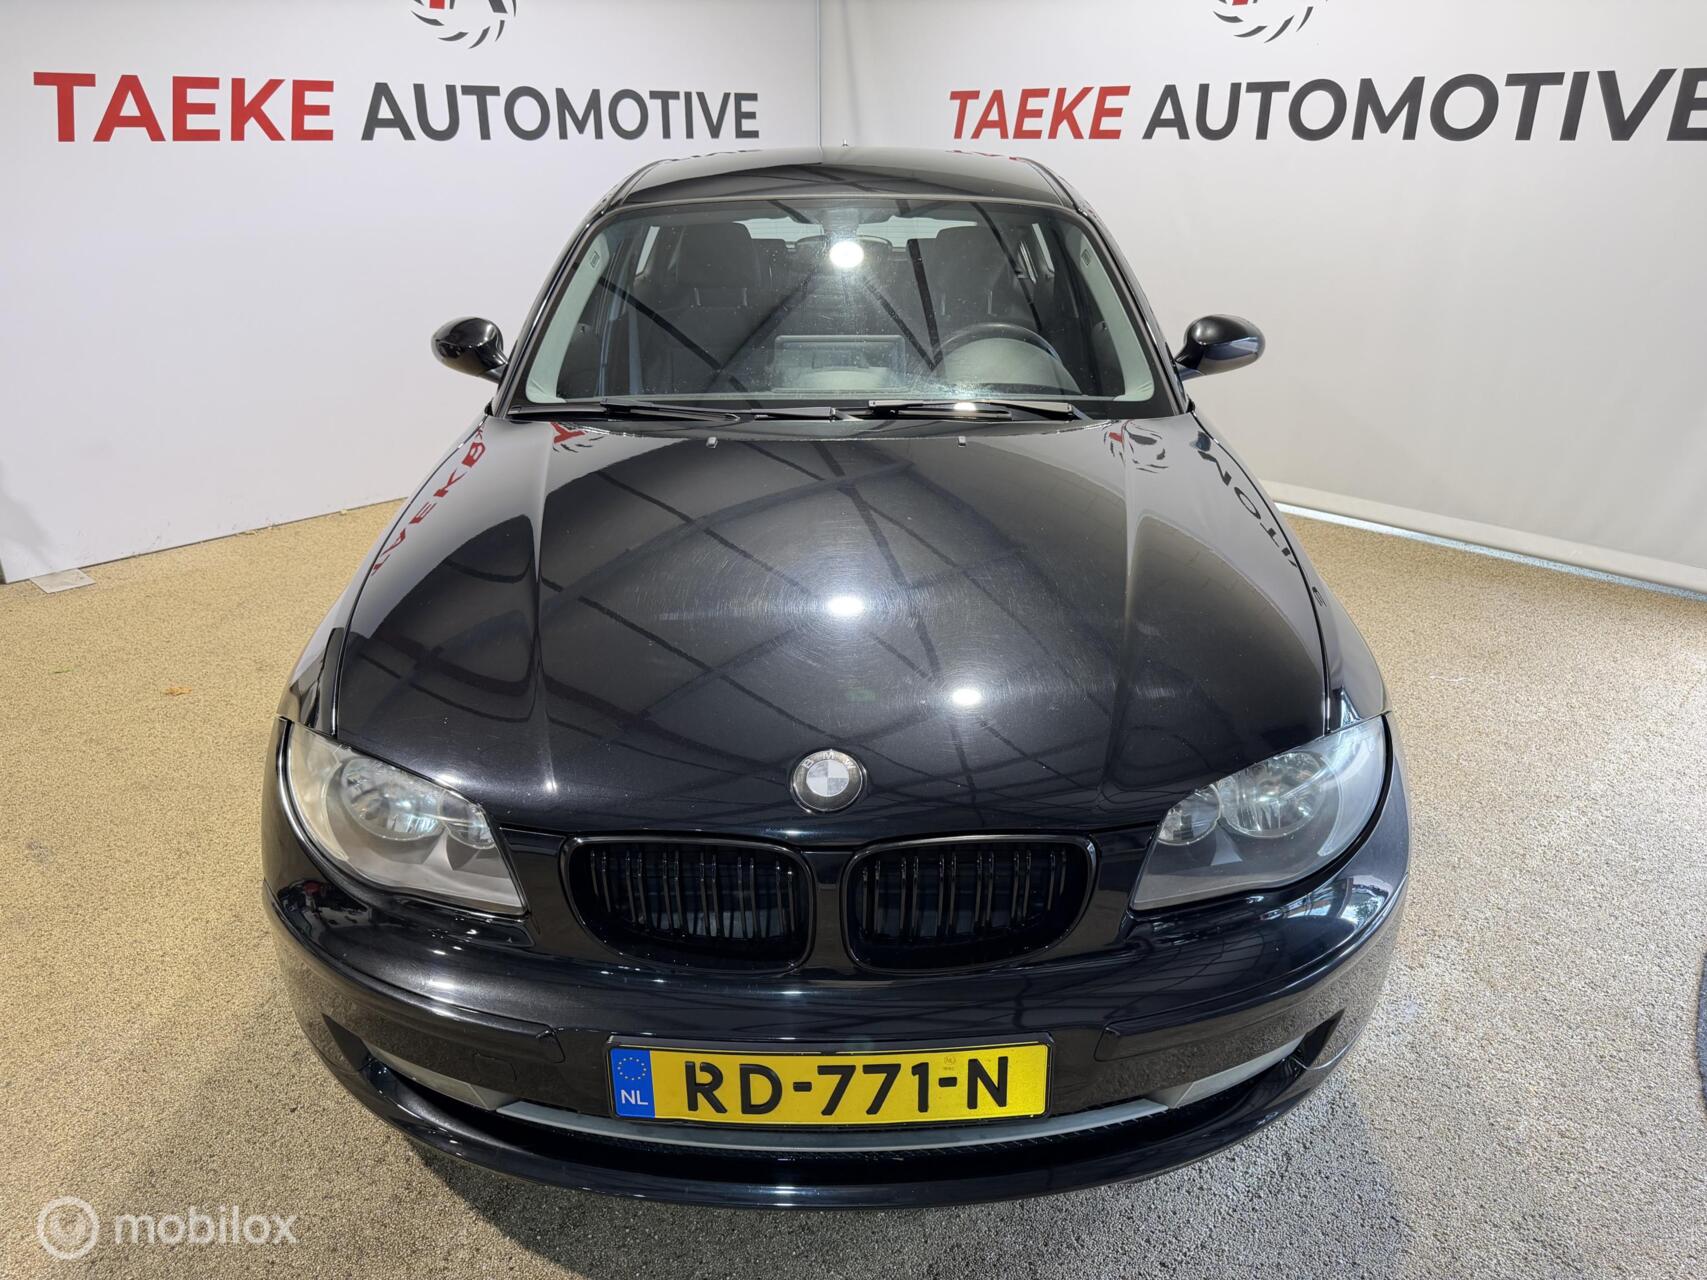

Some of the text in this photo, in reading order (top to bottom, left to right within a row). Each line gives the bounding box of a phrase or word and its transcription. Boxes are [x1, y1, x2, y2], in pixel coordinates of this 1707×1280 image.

[34, 72, 759, 141] TAEKE AUTOMOTIVE
[951, 68, 1707, 141] TAEKE AUTOMOTIVE
[802, 751, 856, 769] BMW
[621, 1089, 648, 1106] NL
[685, 1056, 1009, 1115] RD-771-N
